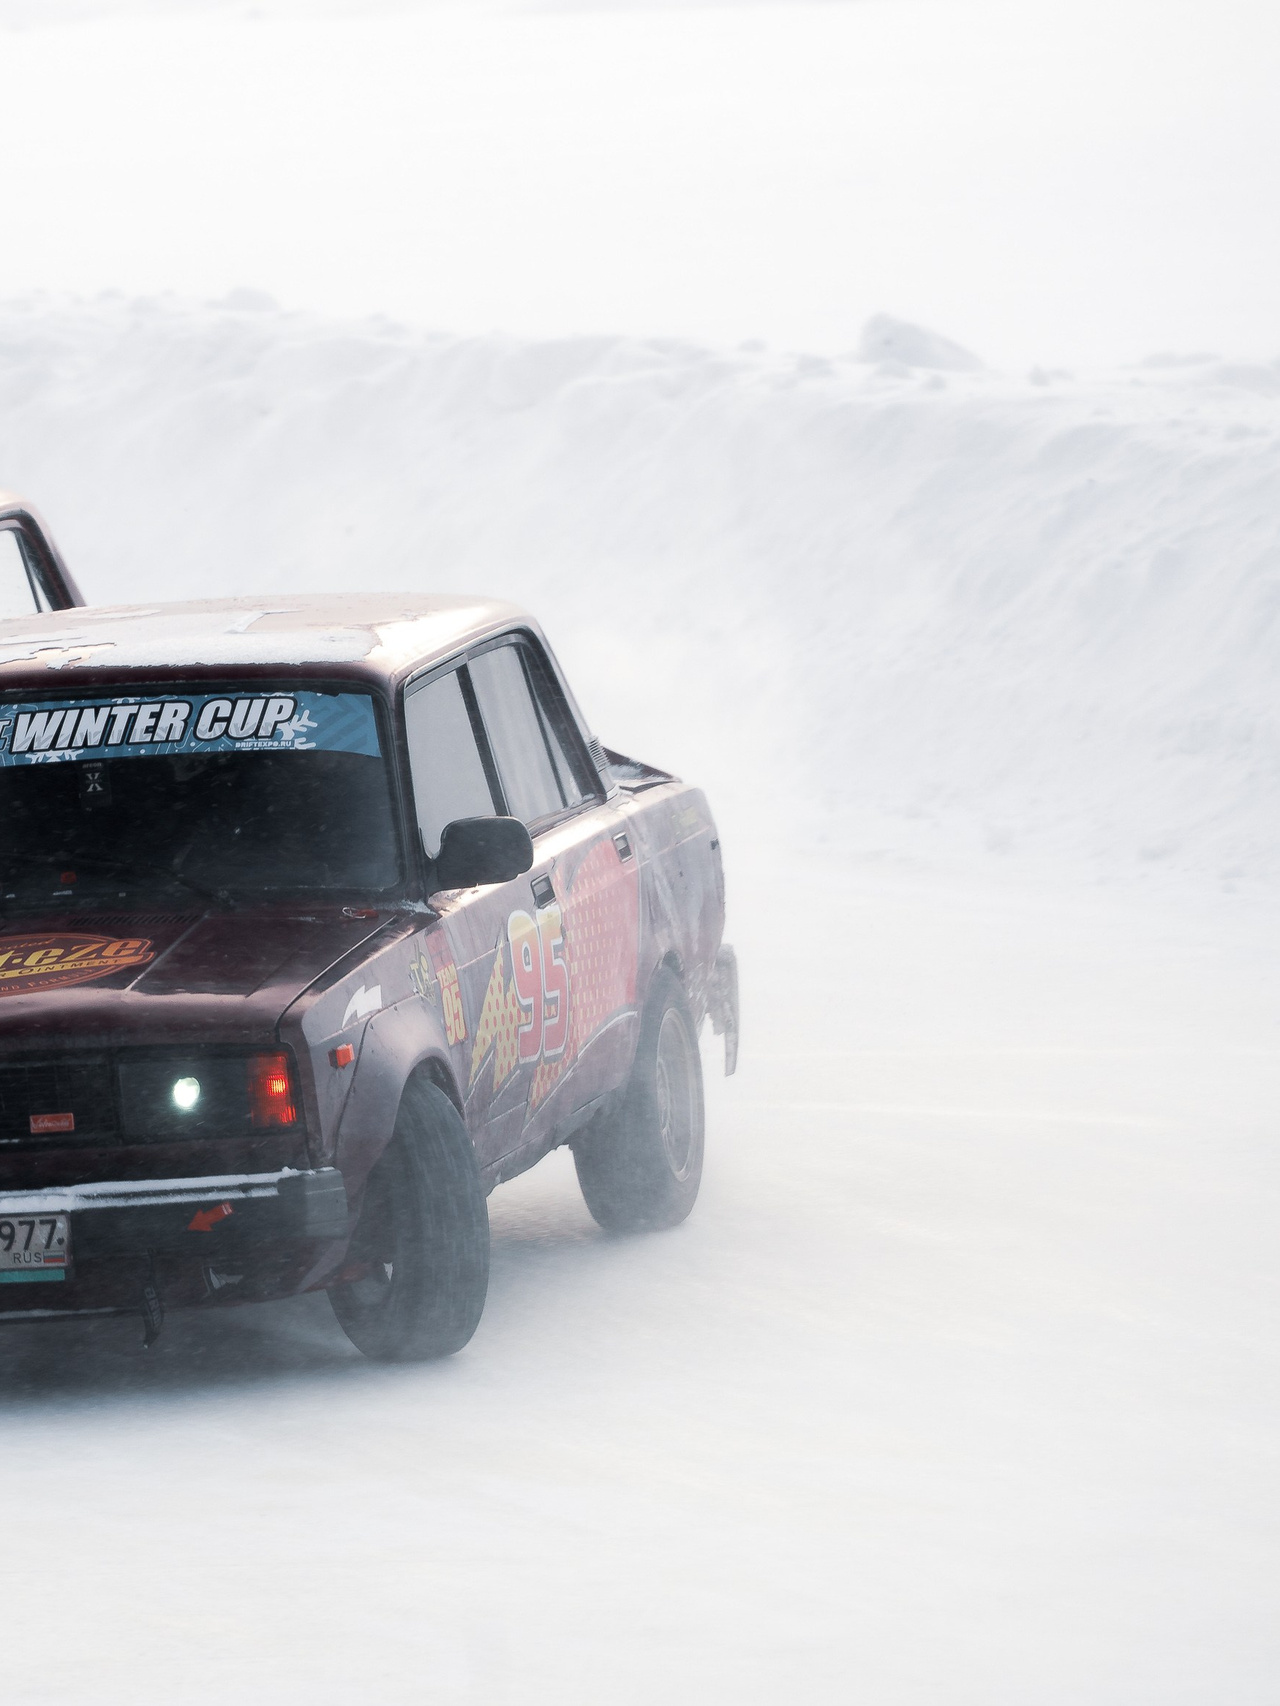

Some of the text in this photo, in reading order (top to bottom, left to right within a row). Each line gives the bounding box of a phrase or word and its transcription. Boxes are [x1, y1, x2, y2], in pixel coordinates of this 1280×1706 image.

[9, 696, 298, 754] WINTER CUP
[235, 740, 292, 748] DRIFTEXPO.RU
[18, 958, 120, 975] OINTMENT
[507, 904, 570, 1064] 95
[442, 982, 466, 1046] 95
[13, 1252, 43, 1263] RUS
